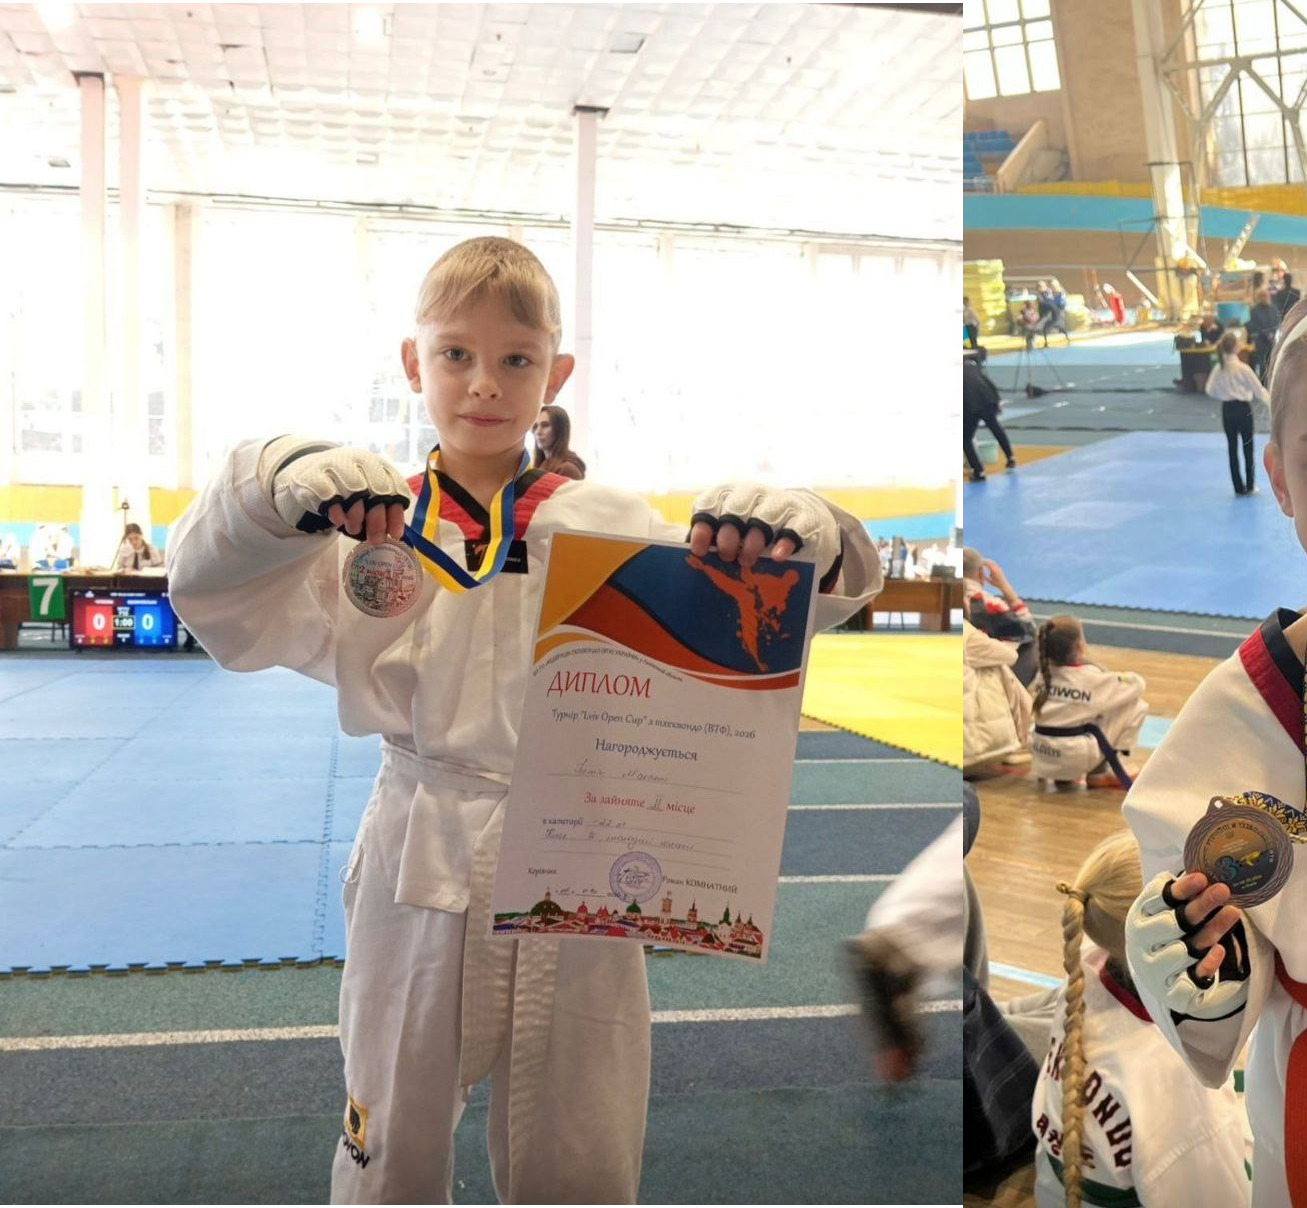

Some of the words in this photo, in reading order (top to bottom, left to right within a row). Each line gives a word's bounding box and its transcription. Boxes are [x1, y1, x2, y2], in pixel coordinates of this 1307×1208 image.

[32, 578, 59, 615] 7
[92, 612, 106, 631] 0
[141, 612, 154, 631] 0
[546, 670, 651, 699] ДИПЛОМ
[601, 711, 623, 724] Open
[595, 738, 698, 760] Нагороджується
[583, 791, 597, 804] За
[665, 801, 696, 815] місце
[684, 877, 739, 895] КОМНАТНИЙ
